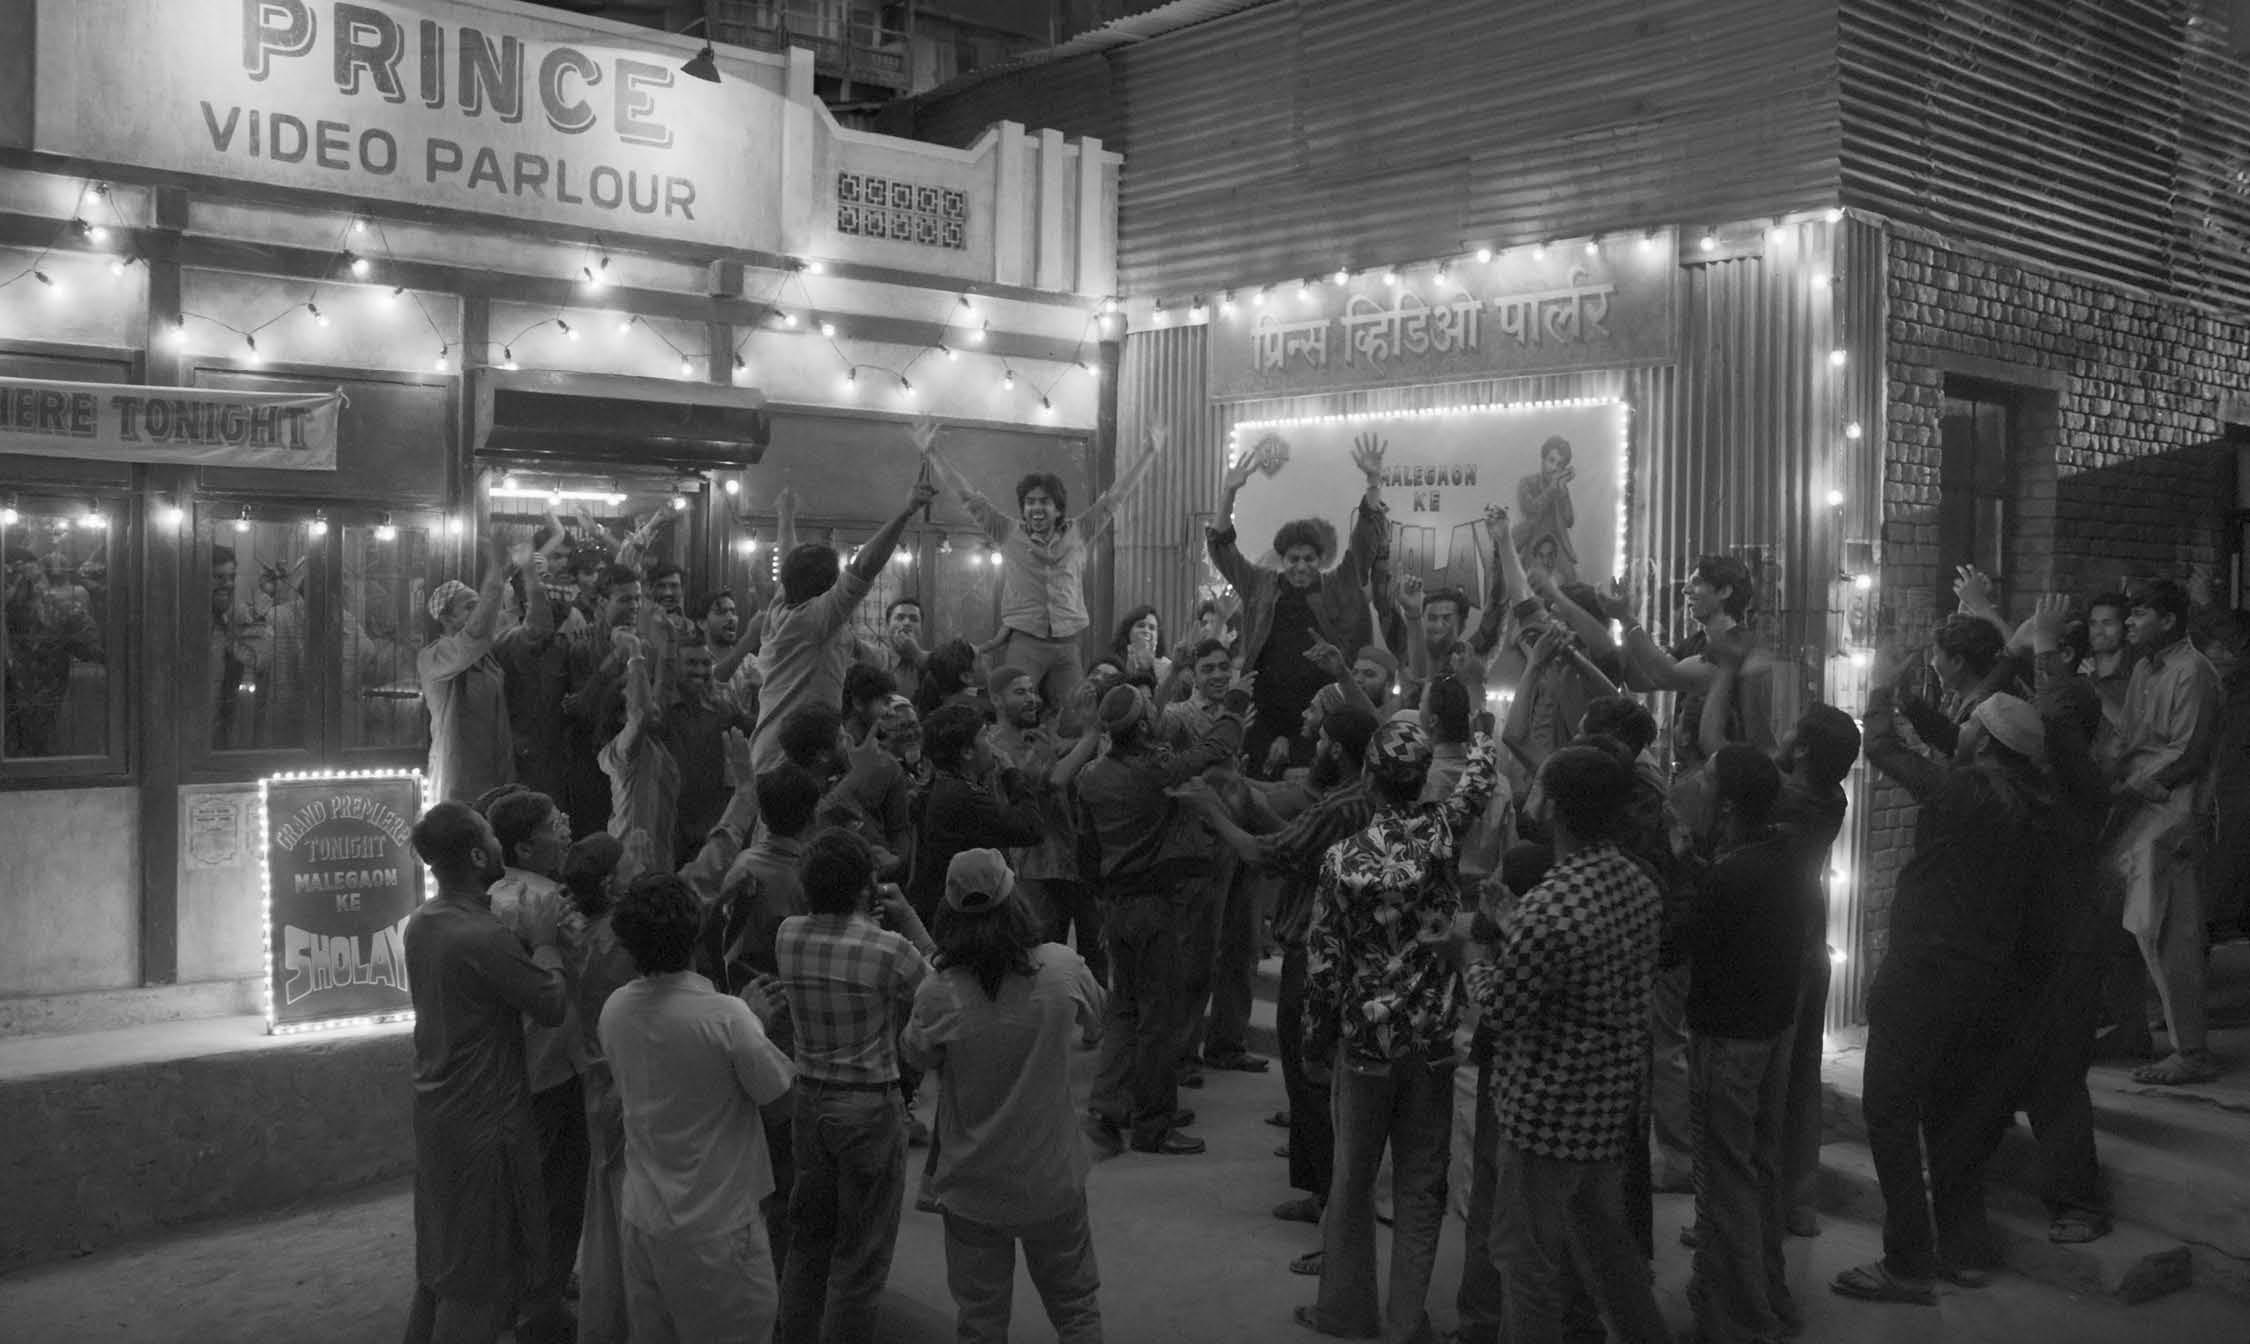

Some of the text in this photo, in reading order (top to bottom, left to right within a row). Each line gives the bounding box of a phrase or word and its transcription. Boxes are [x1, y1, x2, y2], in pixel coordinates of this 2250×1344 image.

[242, 0, 676, 150] PRINCE
[200, 101, 696, 221] VIDEO PARLOUR
[1251, 313, 1331, 371] प्रिन्स
[1493, 266, 1615, 346] पार्लर
[111, 394, 314, 450] TONIGHT
[1379, 463, 1477, 487] MALEGAON
[1413, 490, 1440, 512] KE
[276, 800, 326, 851] GRAND
[304, 834, 387, 863] TONIGHT
[294, 868, 398, 893] MALEGAON
[335, 893, 361, 912] KE
[284, 914, 411, 1005] SHOLAY
